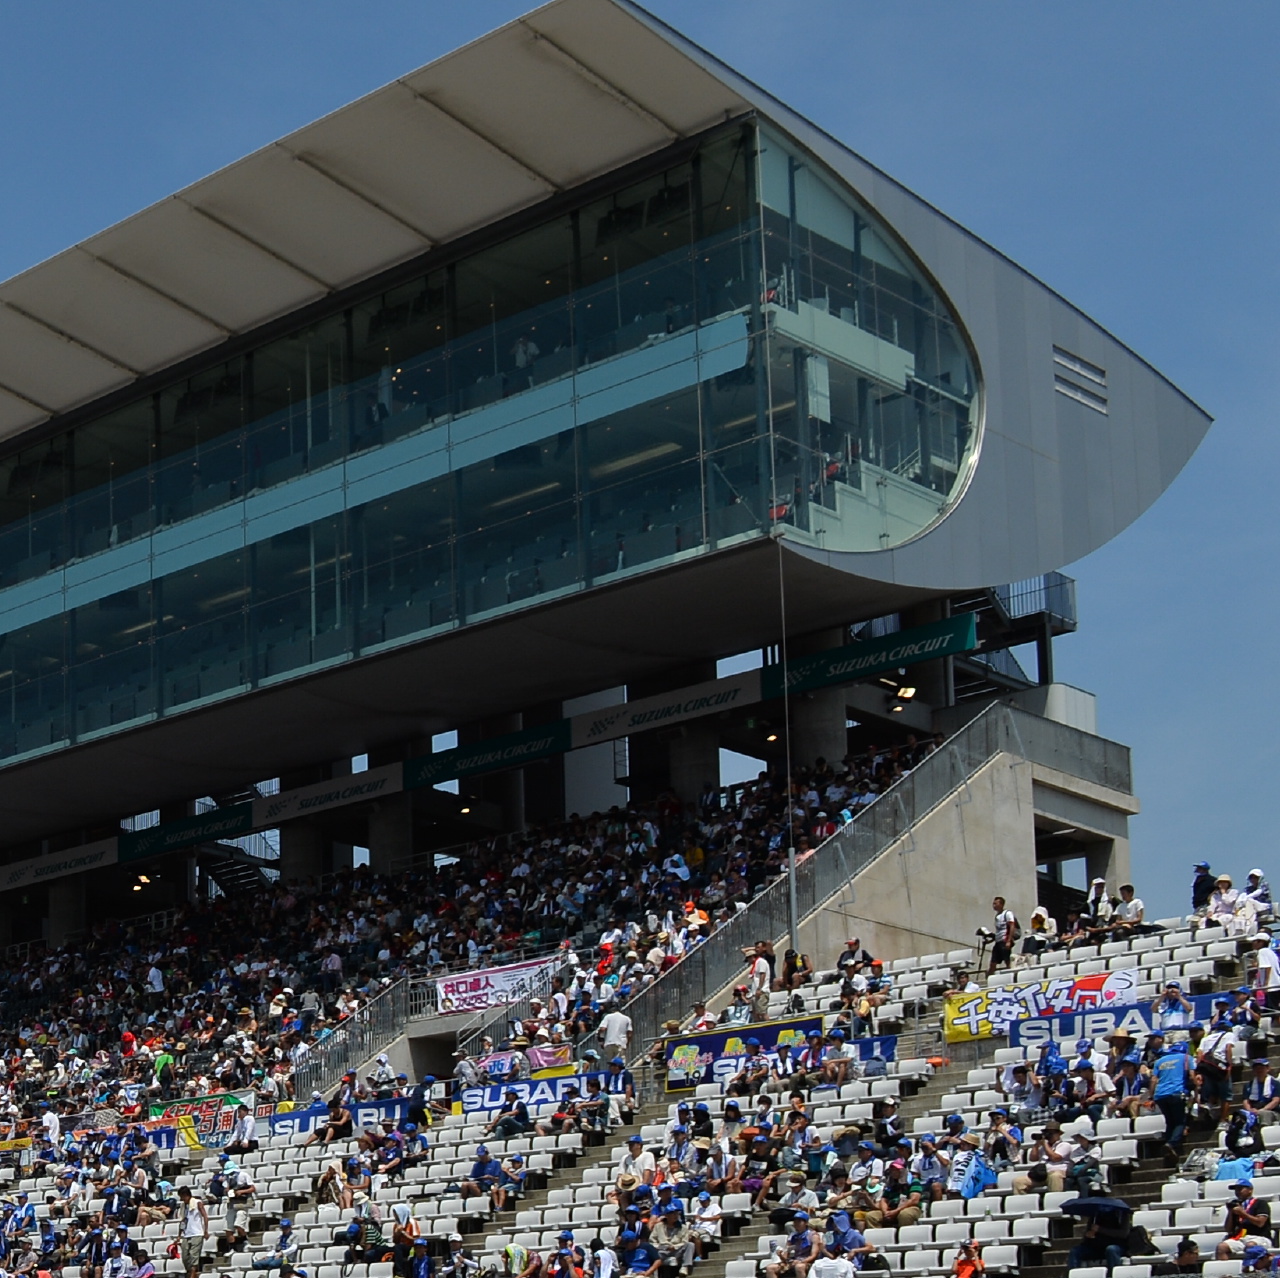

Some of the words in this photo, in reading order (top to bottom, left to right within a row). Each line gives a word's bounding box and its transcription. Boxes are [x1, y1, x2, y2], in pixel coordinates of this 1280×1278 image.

[826, 651, 886, 677] SUZUKA
[888, 633, 954, 658] CIRCUIT
[628, 703, 682, 727] SUZUKA
[683, 688, 741, 713] CIRCUIT
[453, 747, 502, 773] SUZUKA
[503, 736, 555, 759] CIRCUIT
[297, 789, 339, 810] SUZUKA
[339, 777, 387, 799] CIRCUIT
[33, 862, 70, 878] SUZUKA
[70, 851, 106, 868] CIRCUIT
[684, 1069, 701, 1086] 19
